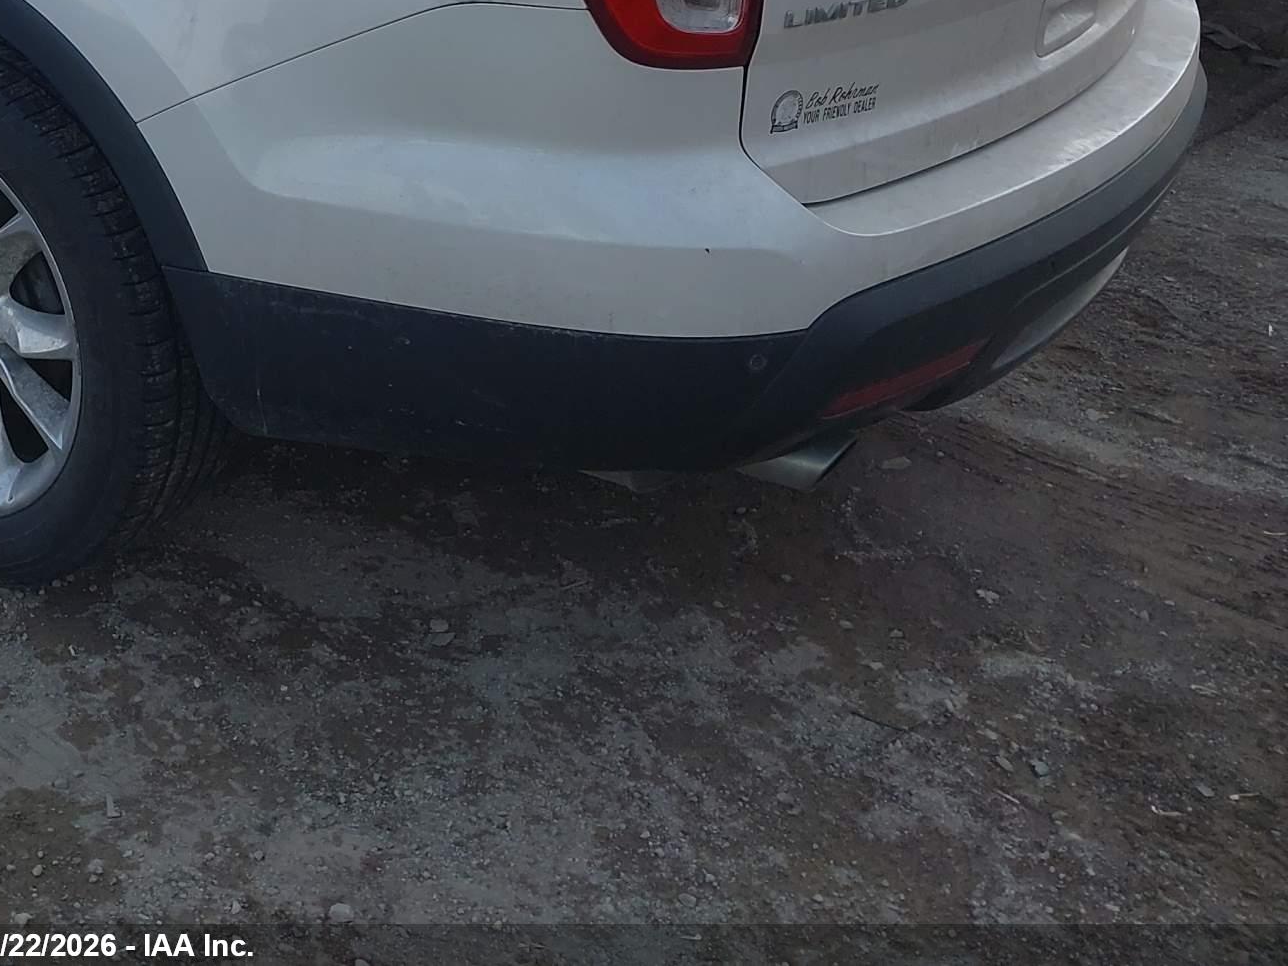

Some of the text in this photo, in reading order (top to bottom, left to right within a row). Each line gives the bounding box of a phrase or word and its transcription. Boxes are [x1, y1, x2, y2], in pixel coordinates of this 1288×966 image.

[803, 96, 877, 125] YOUR FRIENDLY DEALER
